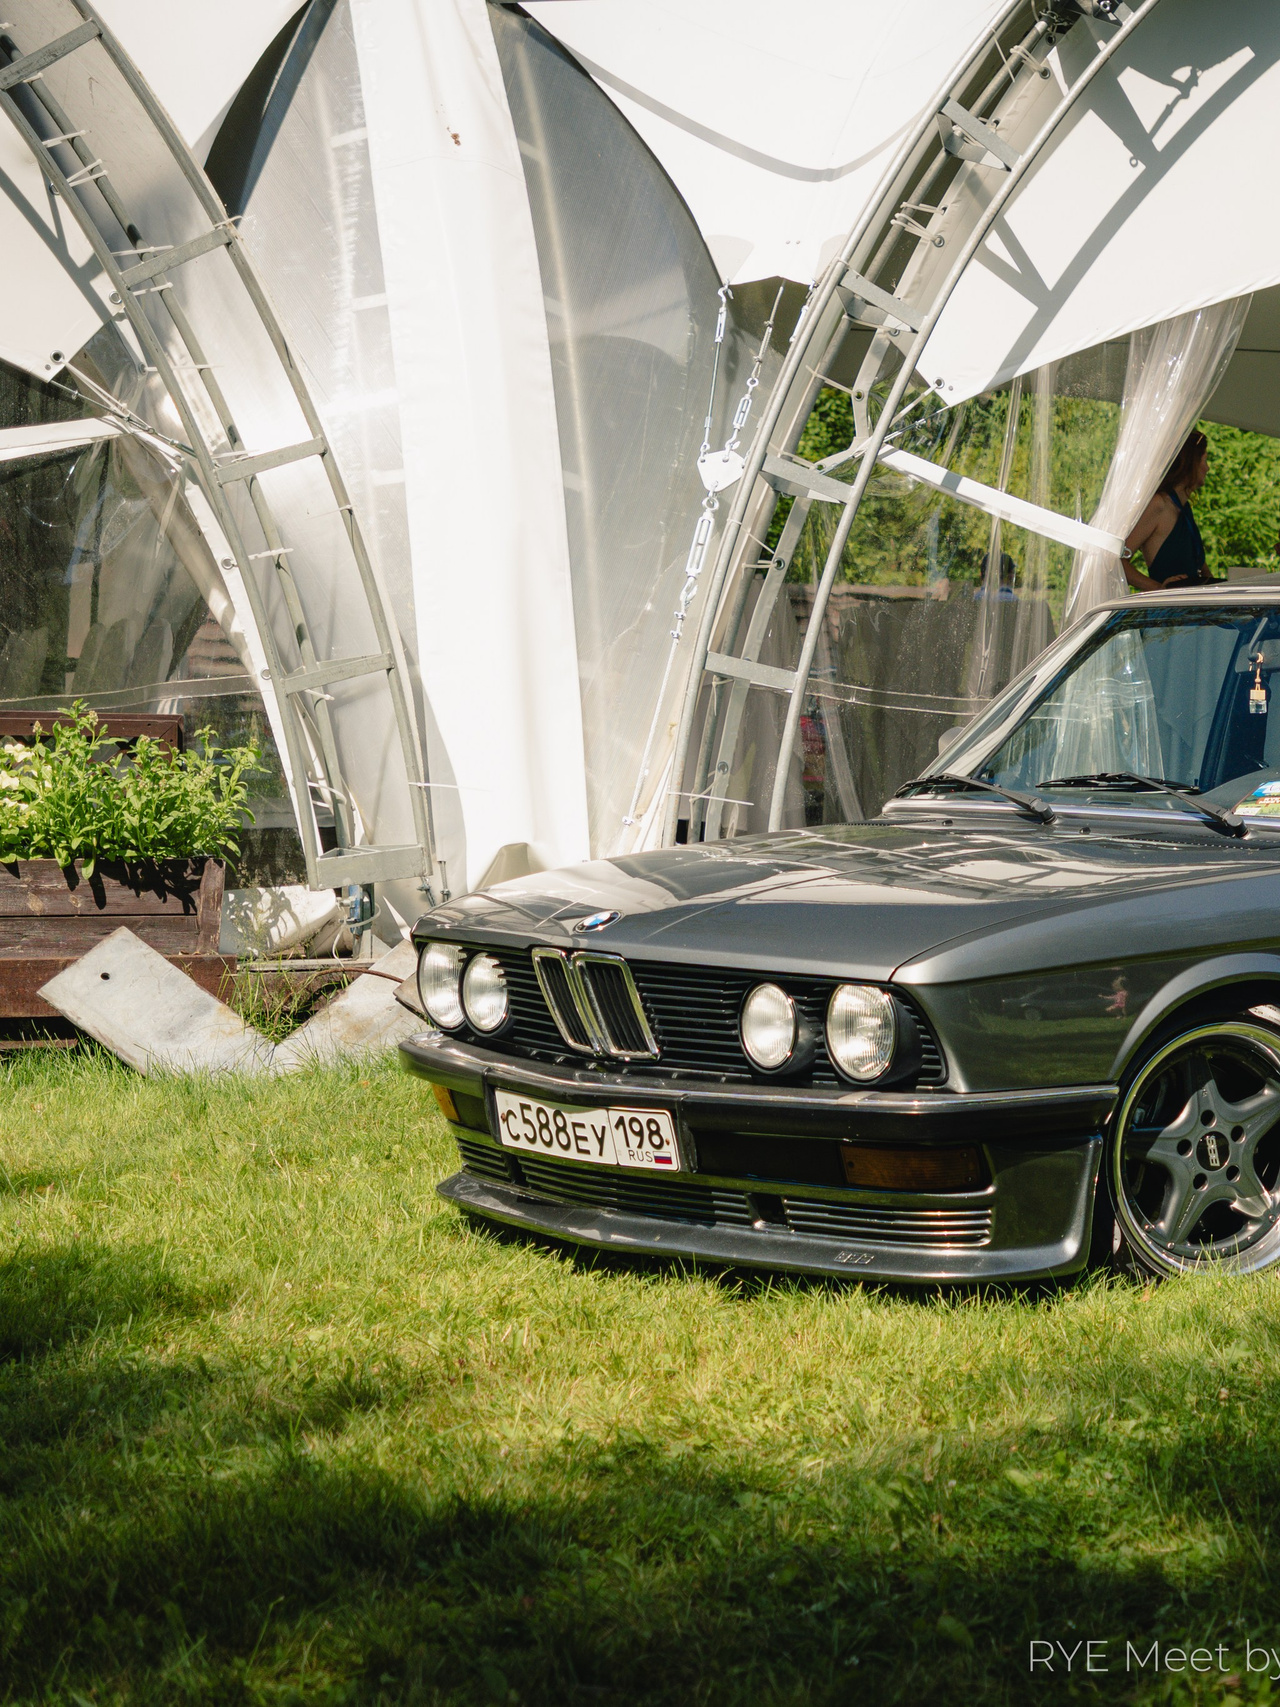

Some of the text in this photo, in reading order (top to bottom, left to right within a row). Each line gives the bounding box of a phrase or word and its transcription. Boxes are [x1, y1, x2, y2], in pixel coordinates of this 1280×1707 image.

[613, 1115, 666, 1149] 198
[628, 1150, 653, 1163] RUS
[1205, 1135, 1220, 1167] BBS
